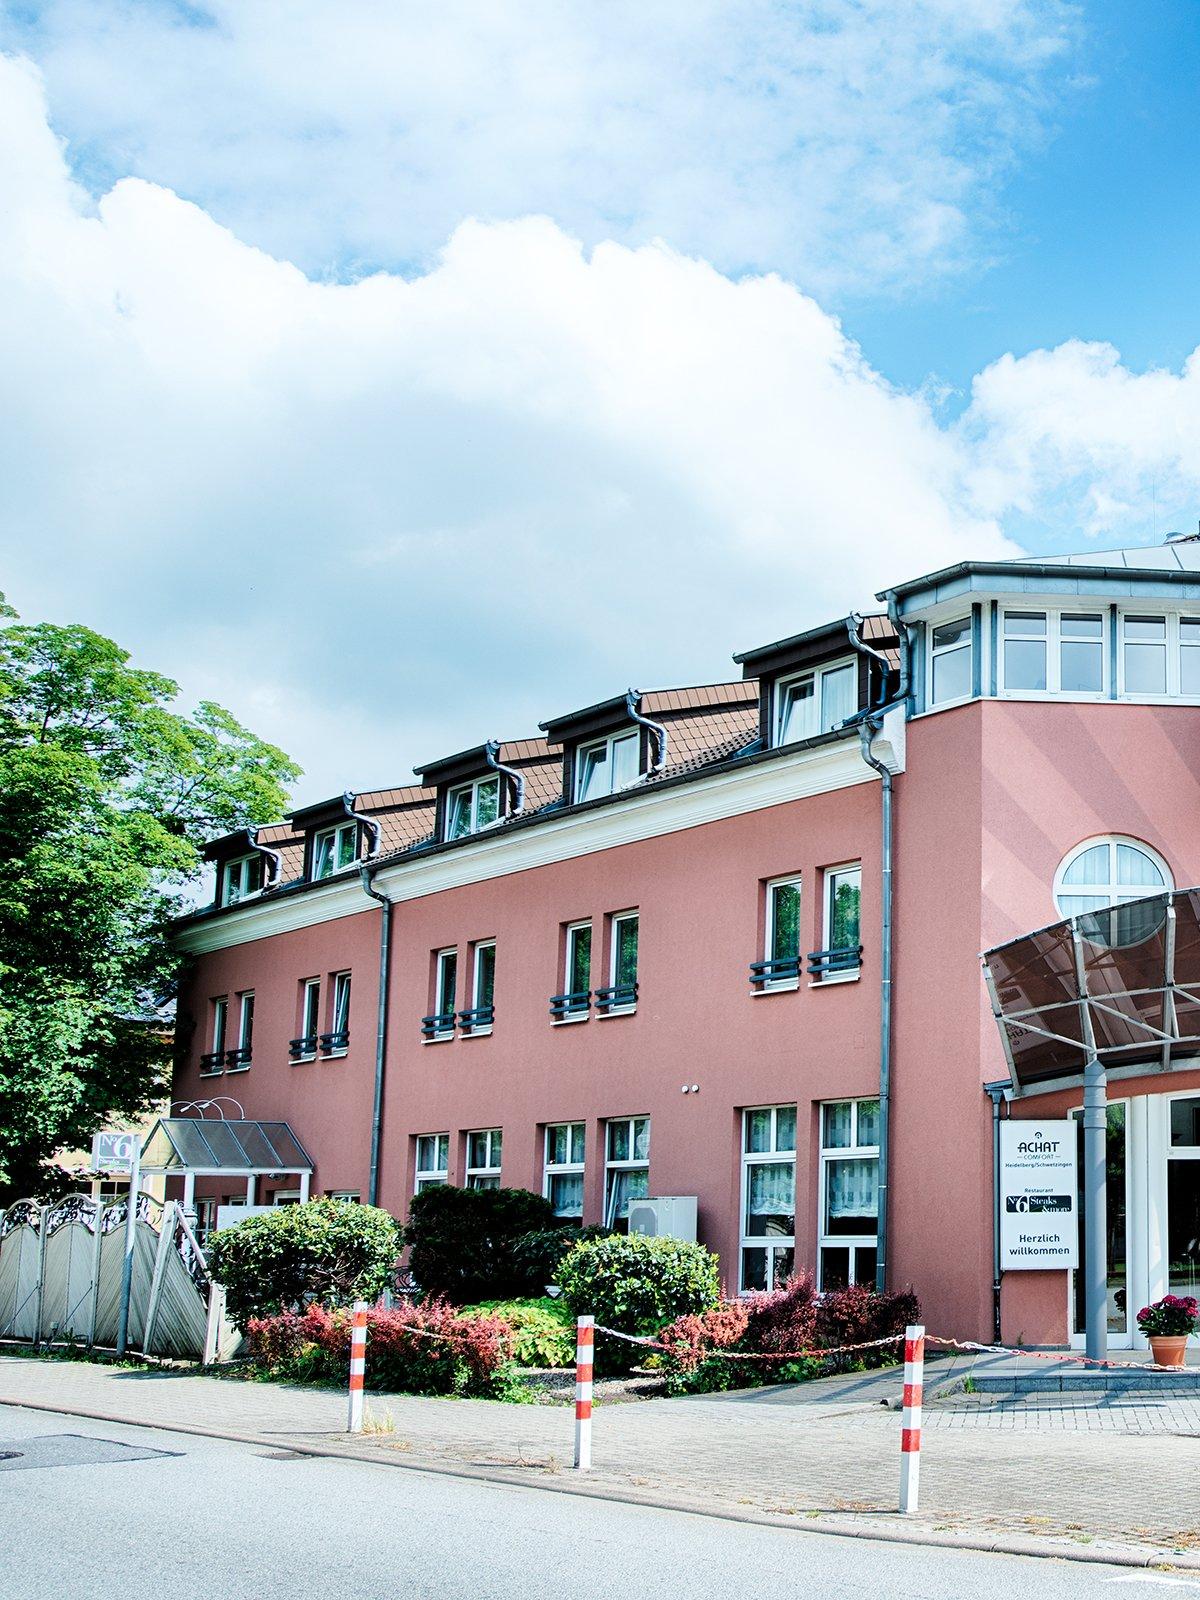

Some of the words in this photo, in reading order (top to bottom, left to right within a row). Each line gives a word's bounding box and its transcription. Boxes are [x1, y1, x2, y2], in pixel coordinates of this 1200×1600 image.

[1017, 1141, 1060, 1153] ACHAT
[1030, 1196, 1057, 1205] Steaks
[1019, 1234, 1060, 1243] Herzlich
[1009, 1247, 1070, 1256] willkommen
